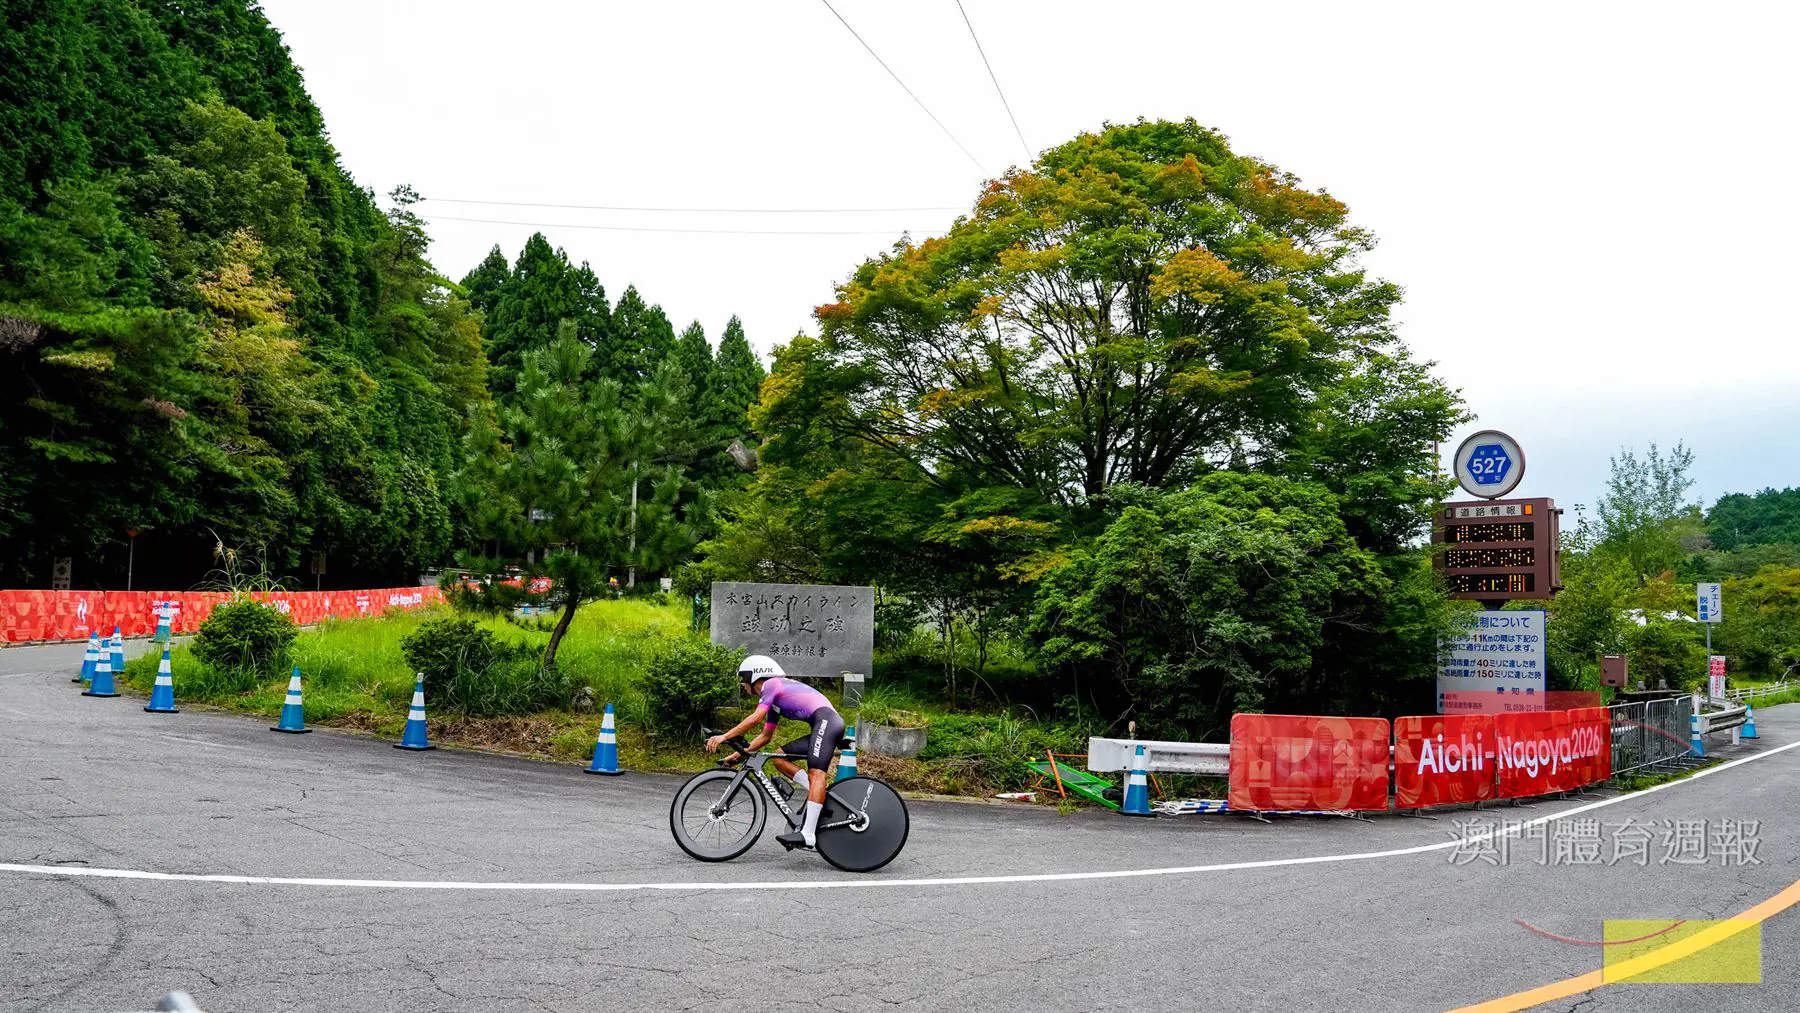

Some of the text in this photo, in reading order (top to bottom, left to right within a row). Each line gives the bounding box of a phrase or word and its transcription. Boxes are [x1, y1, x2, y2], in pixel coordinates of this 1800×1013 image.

[1472, 456, 1507, 474] 527
[1460, 506, 1516, 517] 道路情報
[726, 592, 861, 609] 本宮山スカイライン
[1710, 585, 1719, 617] チェーン
[812, 719, 829, 758] MACAU CHINA
[1571, 726, 1600, 759] 2026
[755, 770, 793, 815] S-WORKS
